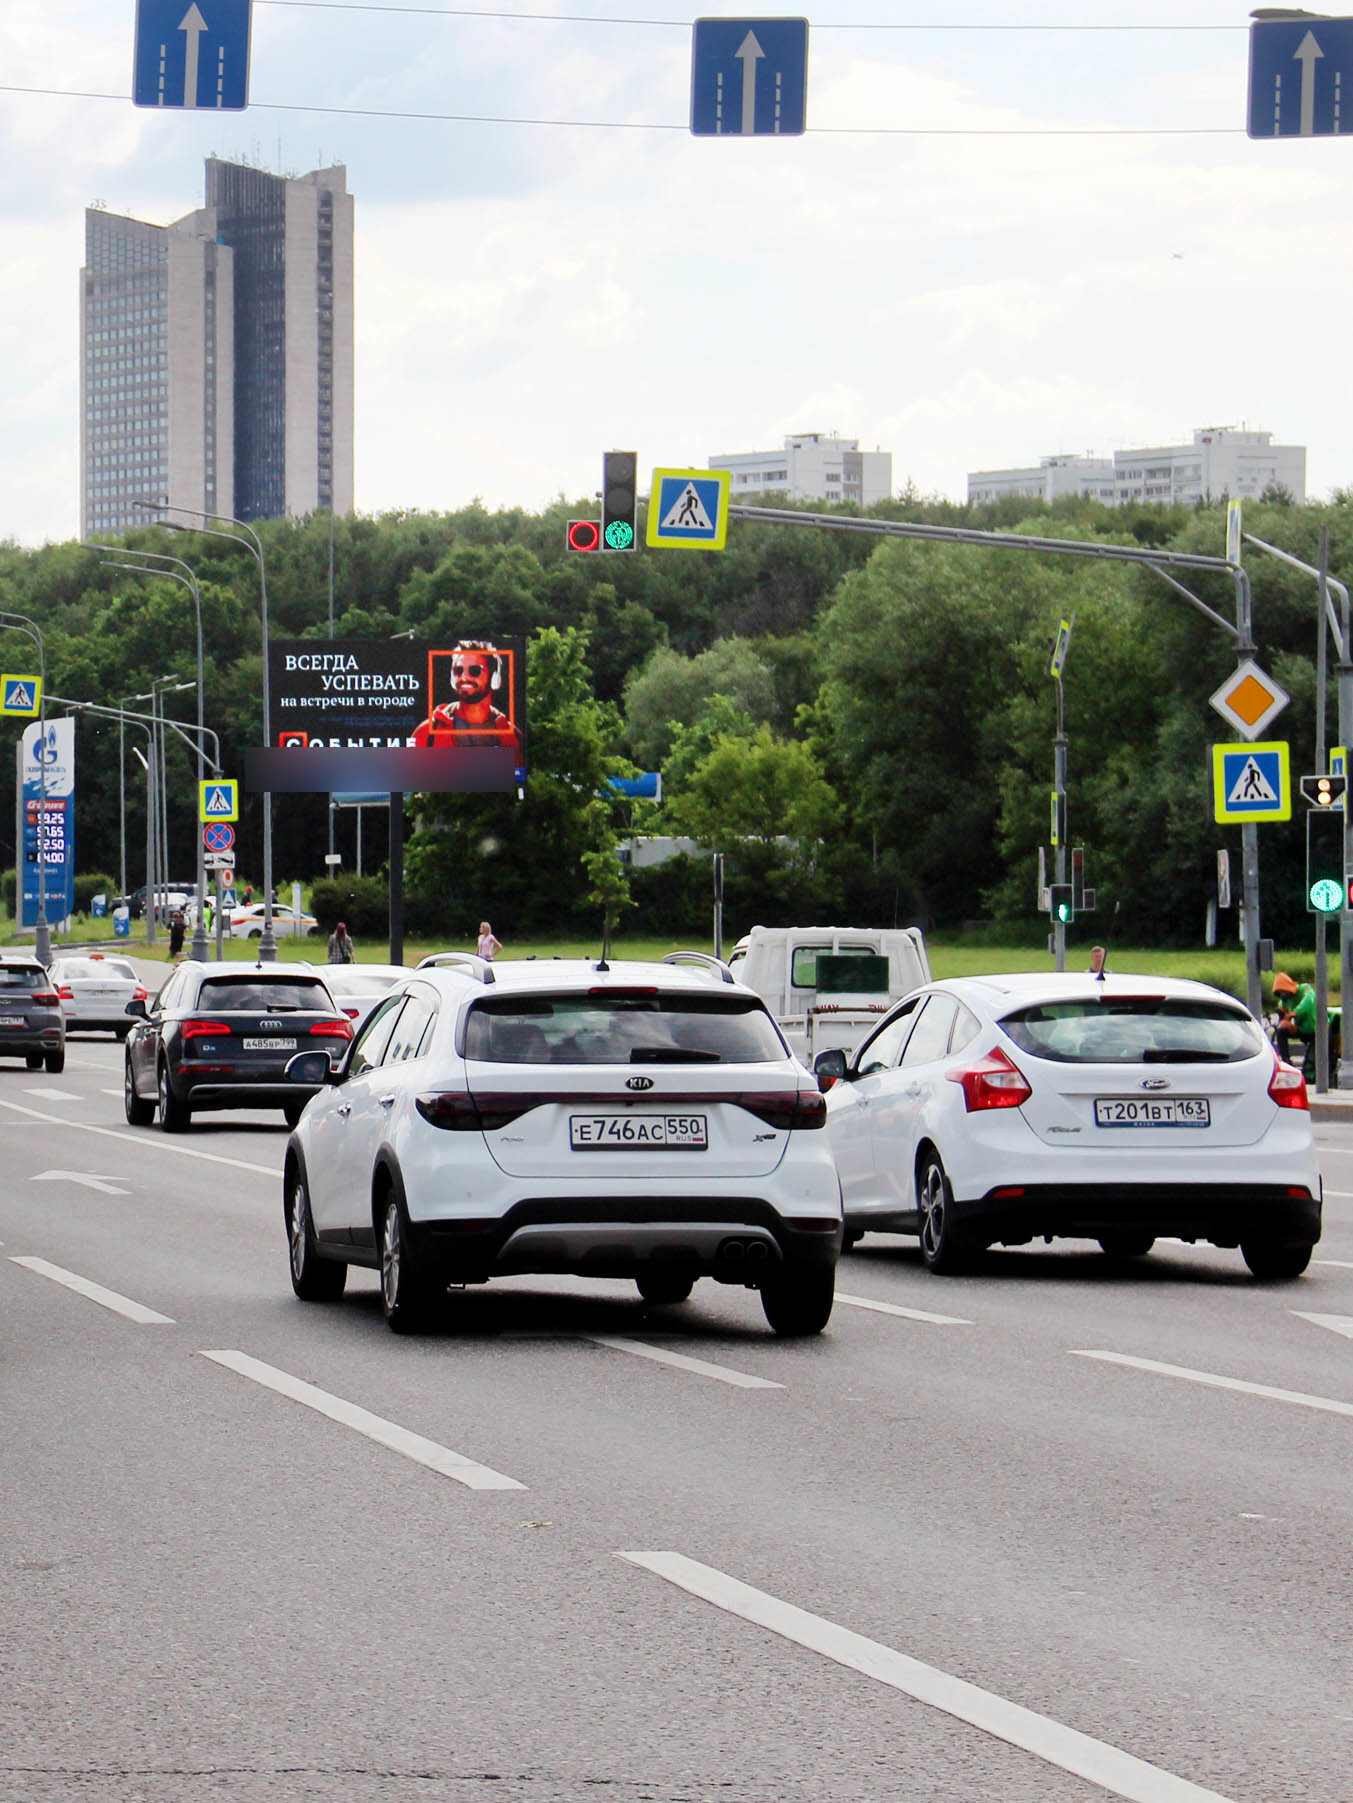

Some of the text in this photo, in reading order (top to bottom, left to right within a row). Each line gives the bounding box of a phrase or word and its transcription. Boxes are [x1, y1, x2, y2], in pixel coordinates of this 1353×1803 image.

[285, 654, 359, 673] ВСЕГДА
[320, 674, 420, 691] УСПЕВАТЬ
[280, 696, 415, 710] на встречи в городе
[629, 1078, 651, 1088] KIA
[1177, 1101, 1203, 1115] 163
[668, 1119, 700, 1134] 550
